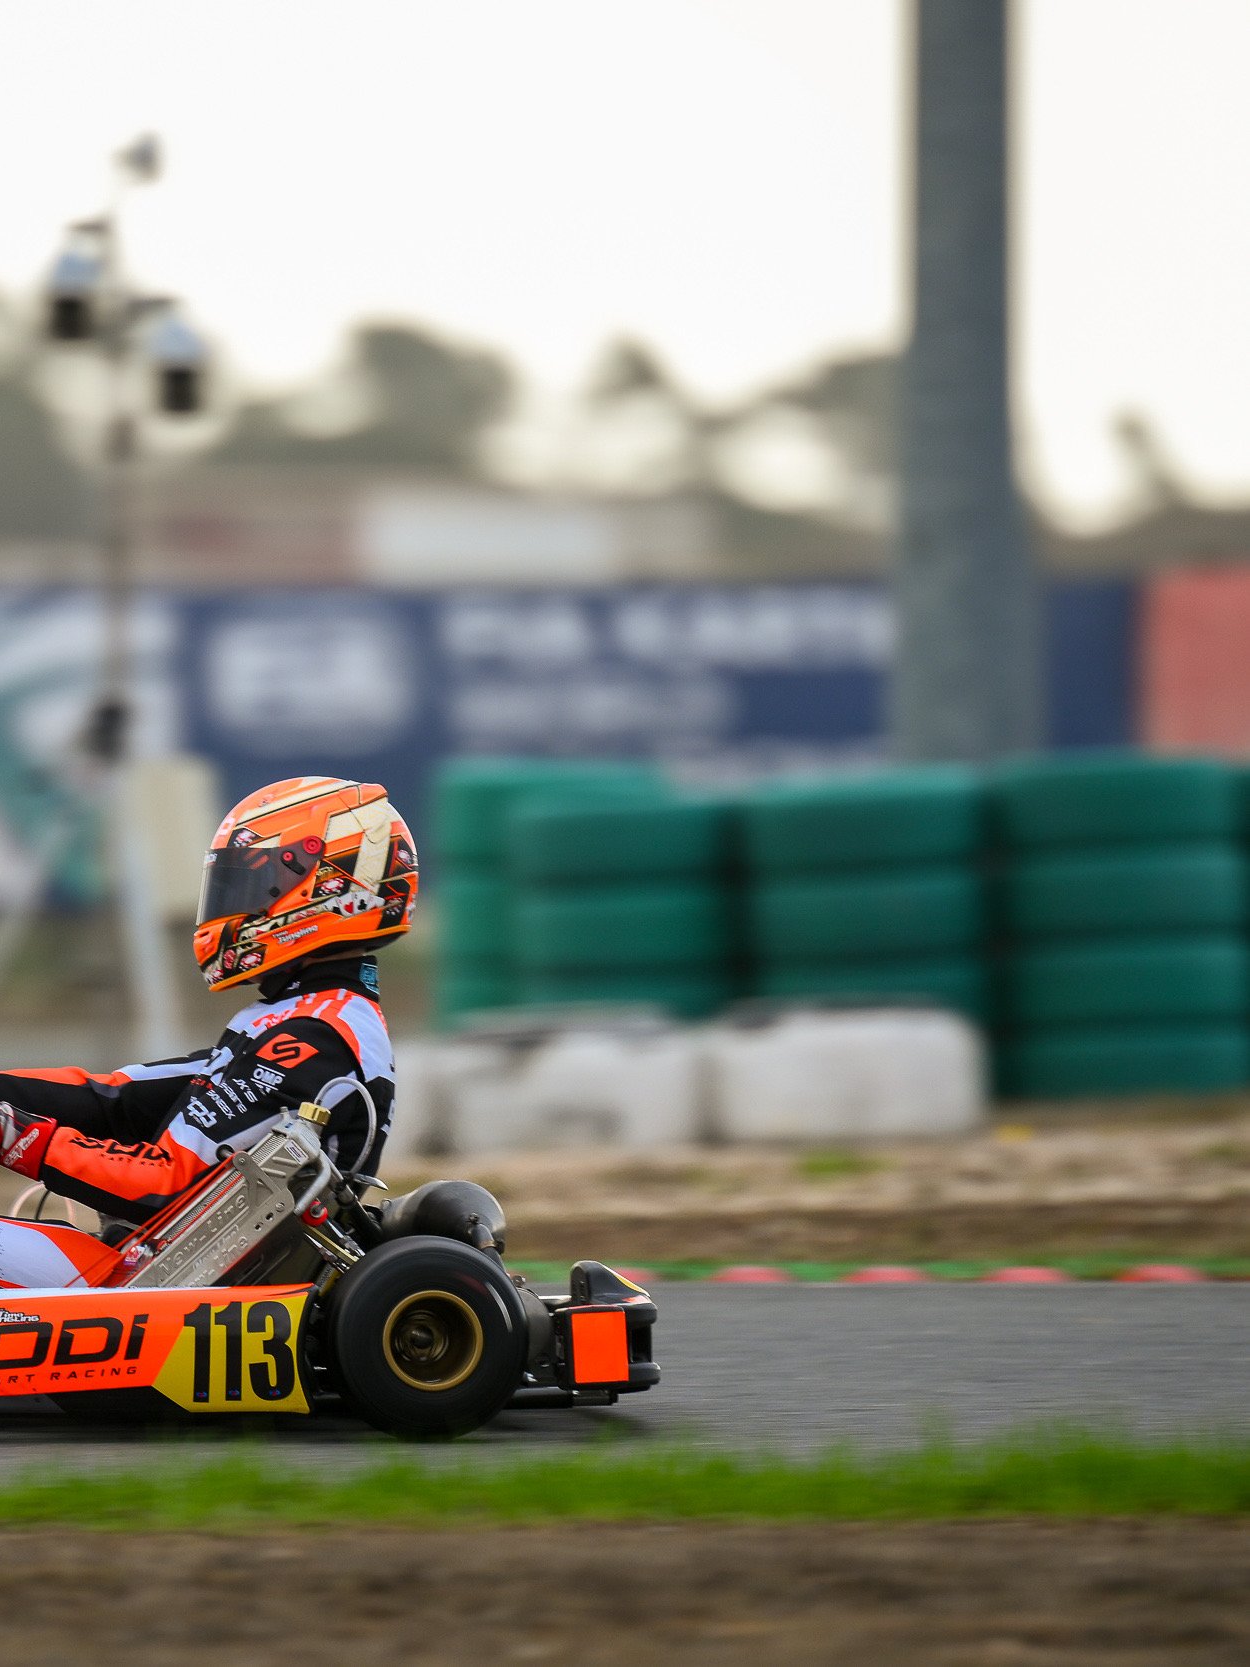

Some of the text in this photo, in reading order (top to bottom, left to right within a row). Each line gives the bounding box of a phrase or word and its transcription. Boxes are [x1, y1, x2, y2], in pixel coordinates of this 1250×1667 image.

[253, 1067, 283, 1085] OMP
[183, 1301, 295, 1403] 113
[50, 1366, 138, 1381] RACING
